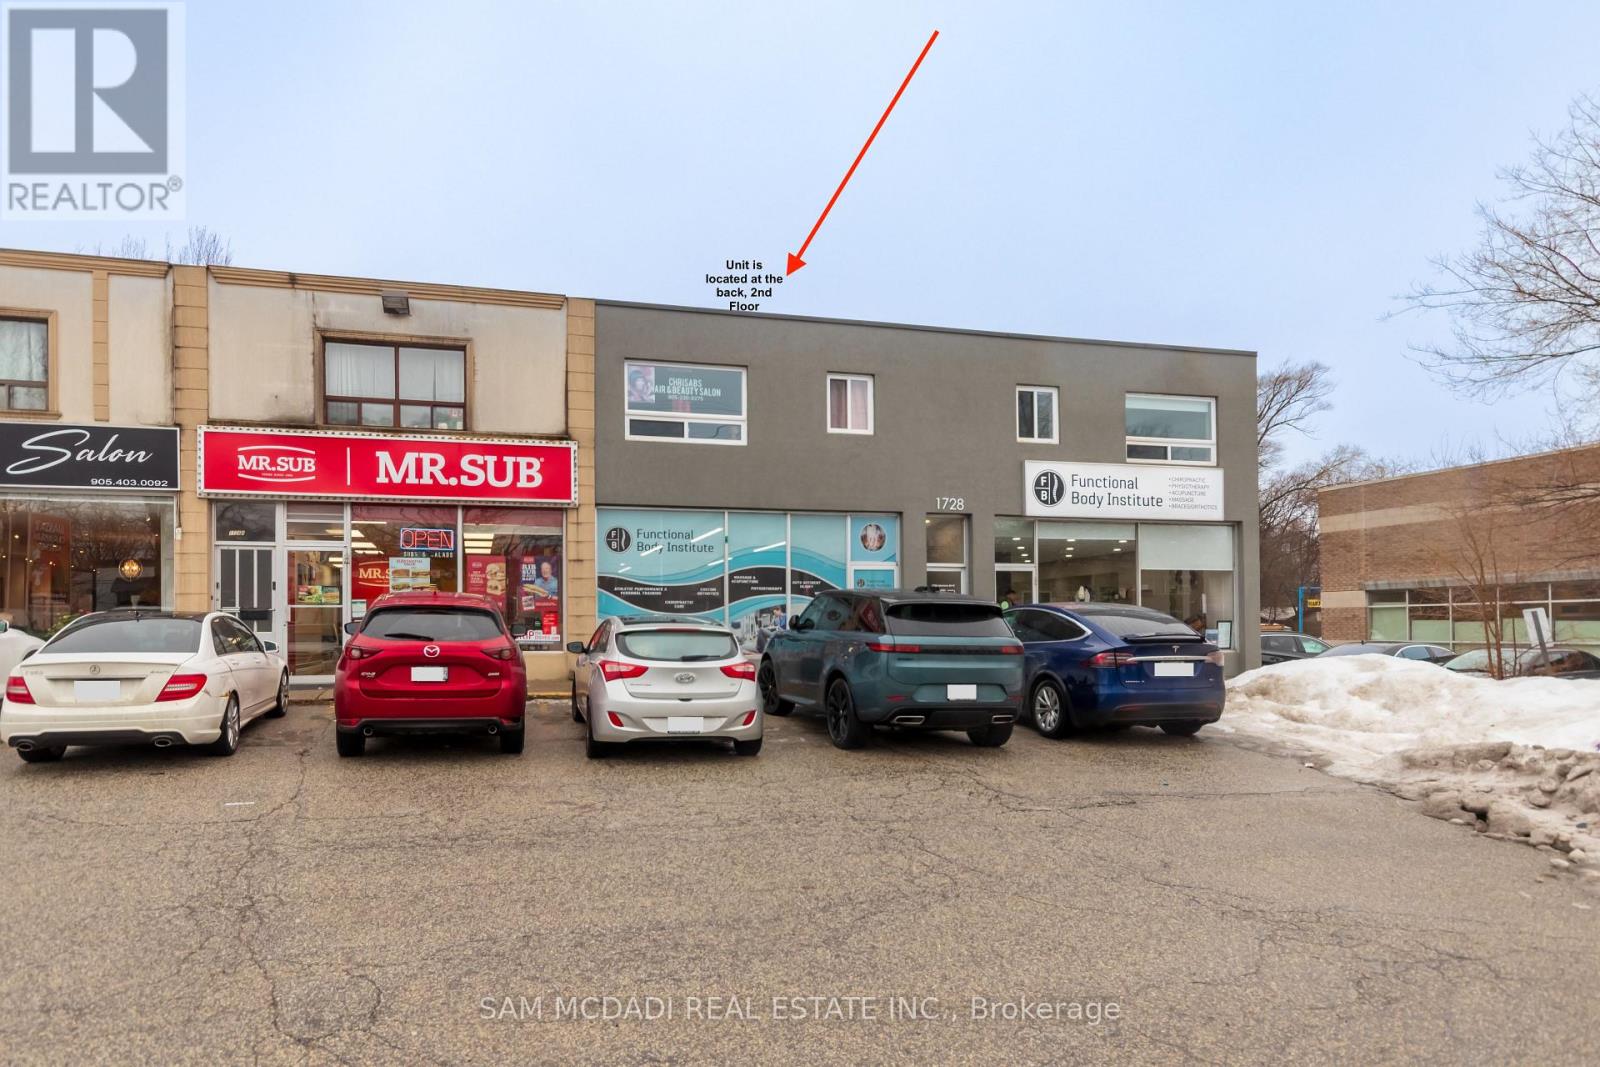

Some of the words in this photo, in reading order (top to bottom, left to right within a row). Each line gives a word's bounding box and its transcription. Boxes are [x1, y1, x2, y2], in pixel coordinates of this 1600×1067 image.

[672, 385, 699, 396] BEAUTY
[699, 387, 721, 397] SALON
[6, 429, 153, 474] Salon
[237, 454, 316, 473] MR.SUB
[375, 451, 543, 488] MR.SUB
[90, 478, 169, 488] 905.403.0092
[1071, 473, 1138, 490] Functional
[936, 497, 965, 511] 1728
[1071, 491, 1104, 508] Body
[1107, 492, 1163, 507] Institute
[402, 529, 452, 549] OPEN
[637, 528, 694, 540] Functional
[637, 541, 662, 554] Body
[667, 542, 714, 553] Institute
